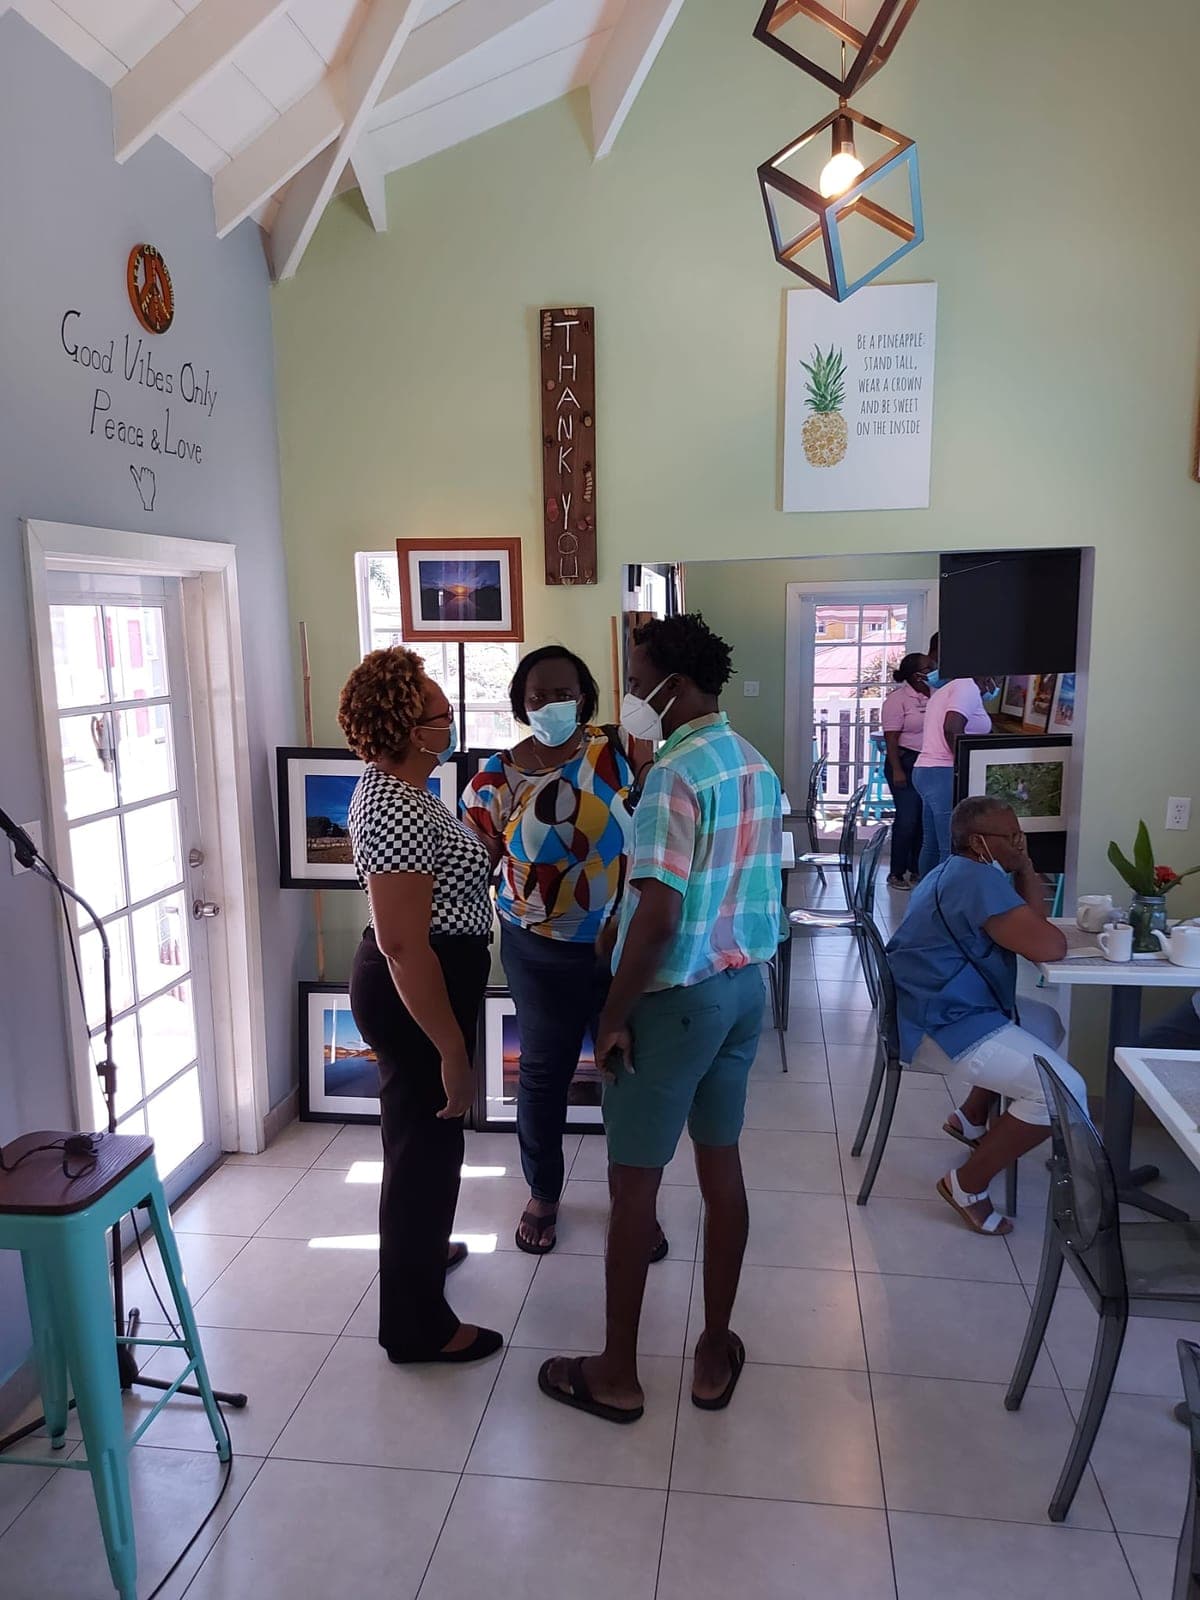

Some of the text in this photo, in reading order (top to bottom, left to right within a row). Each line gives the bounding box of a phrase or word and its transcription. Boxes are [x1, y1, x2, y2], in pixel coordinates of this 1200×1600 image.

[857, 334, 866, 350] BE
[869, 334, 875, 350] A
[61, 310, 217, 417] Good Vibes Only
[863, 354, 918, 371] STAND TALL,
[858, 376, 923, 393] WEAR A CROWN
[553, 320, 581, 474] THANK
[860, 398, 919, 415] AND BE SWEET
[90, 388, 203, 464] Peace & Love
[856, 419, 921, 436] ON THE INSIDE
[557, 492, 579, 578] YOU
